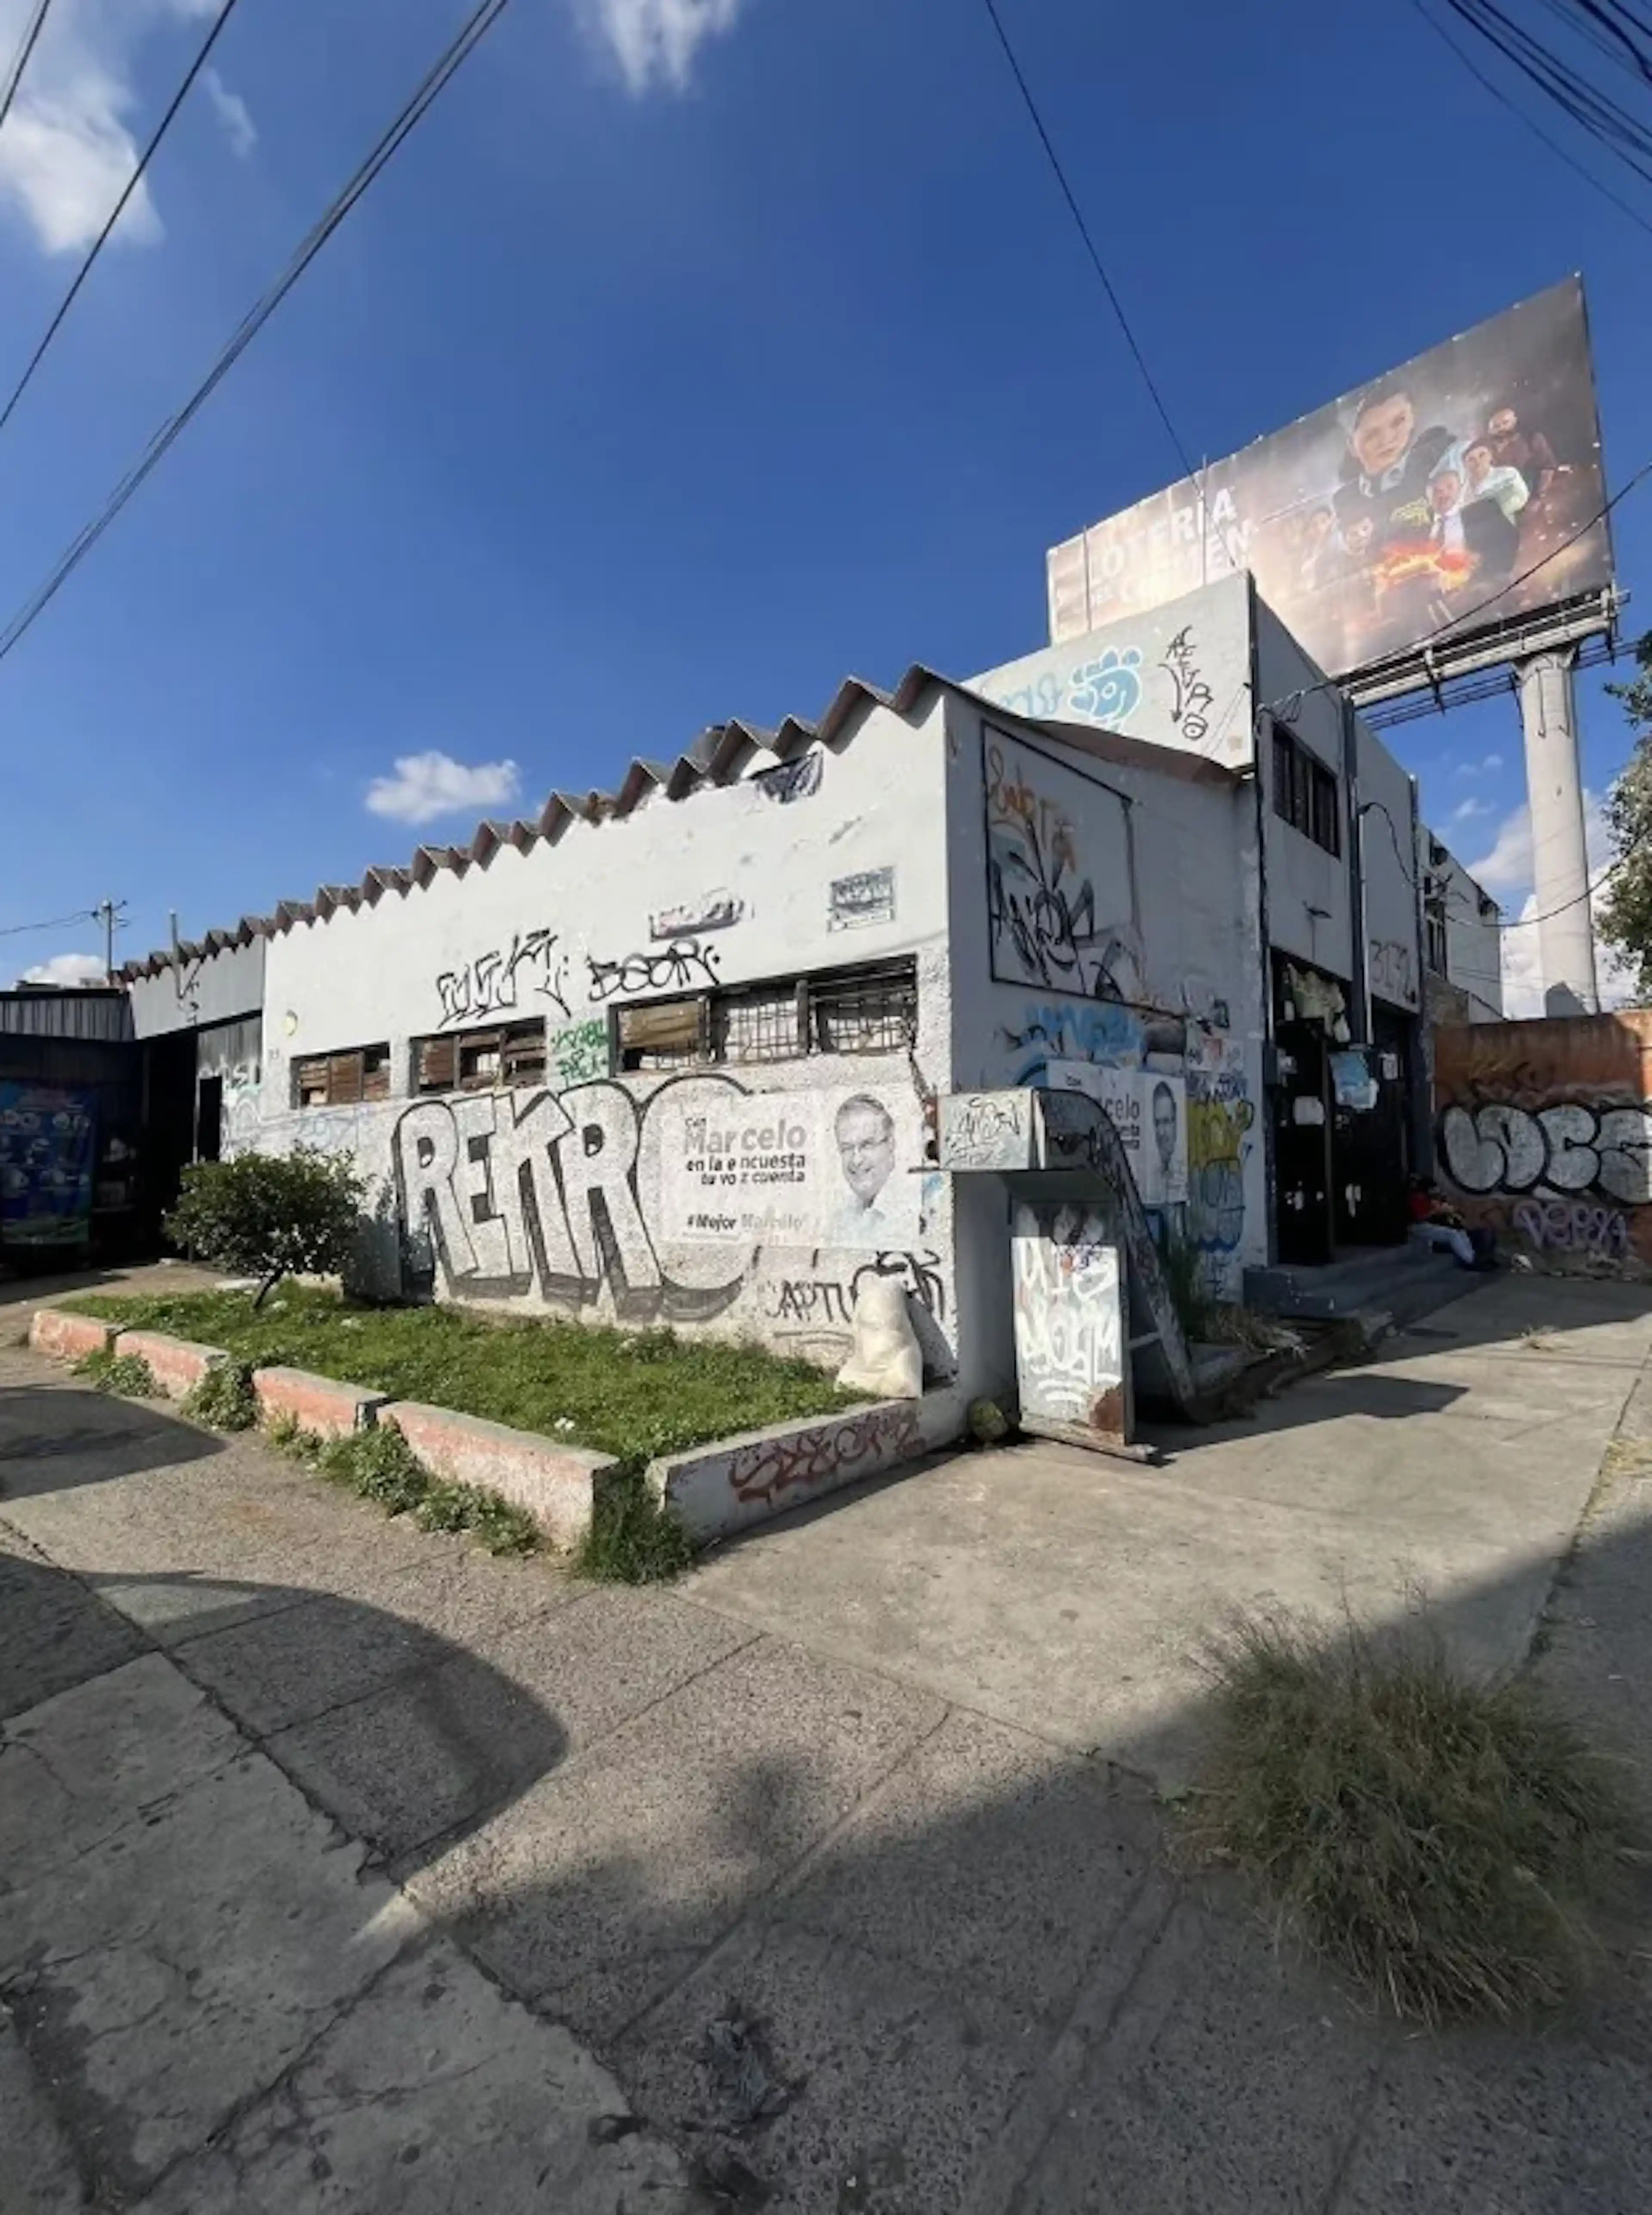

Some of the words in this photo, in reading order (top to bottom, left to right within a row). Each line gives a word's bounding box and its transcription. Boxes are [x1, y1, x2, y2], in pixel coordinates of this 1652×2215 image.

[684, 1118, 807, 1155] Marcelo
[686, 1160, 704, 1171] en
[709, 1155, 722, 1171] la
